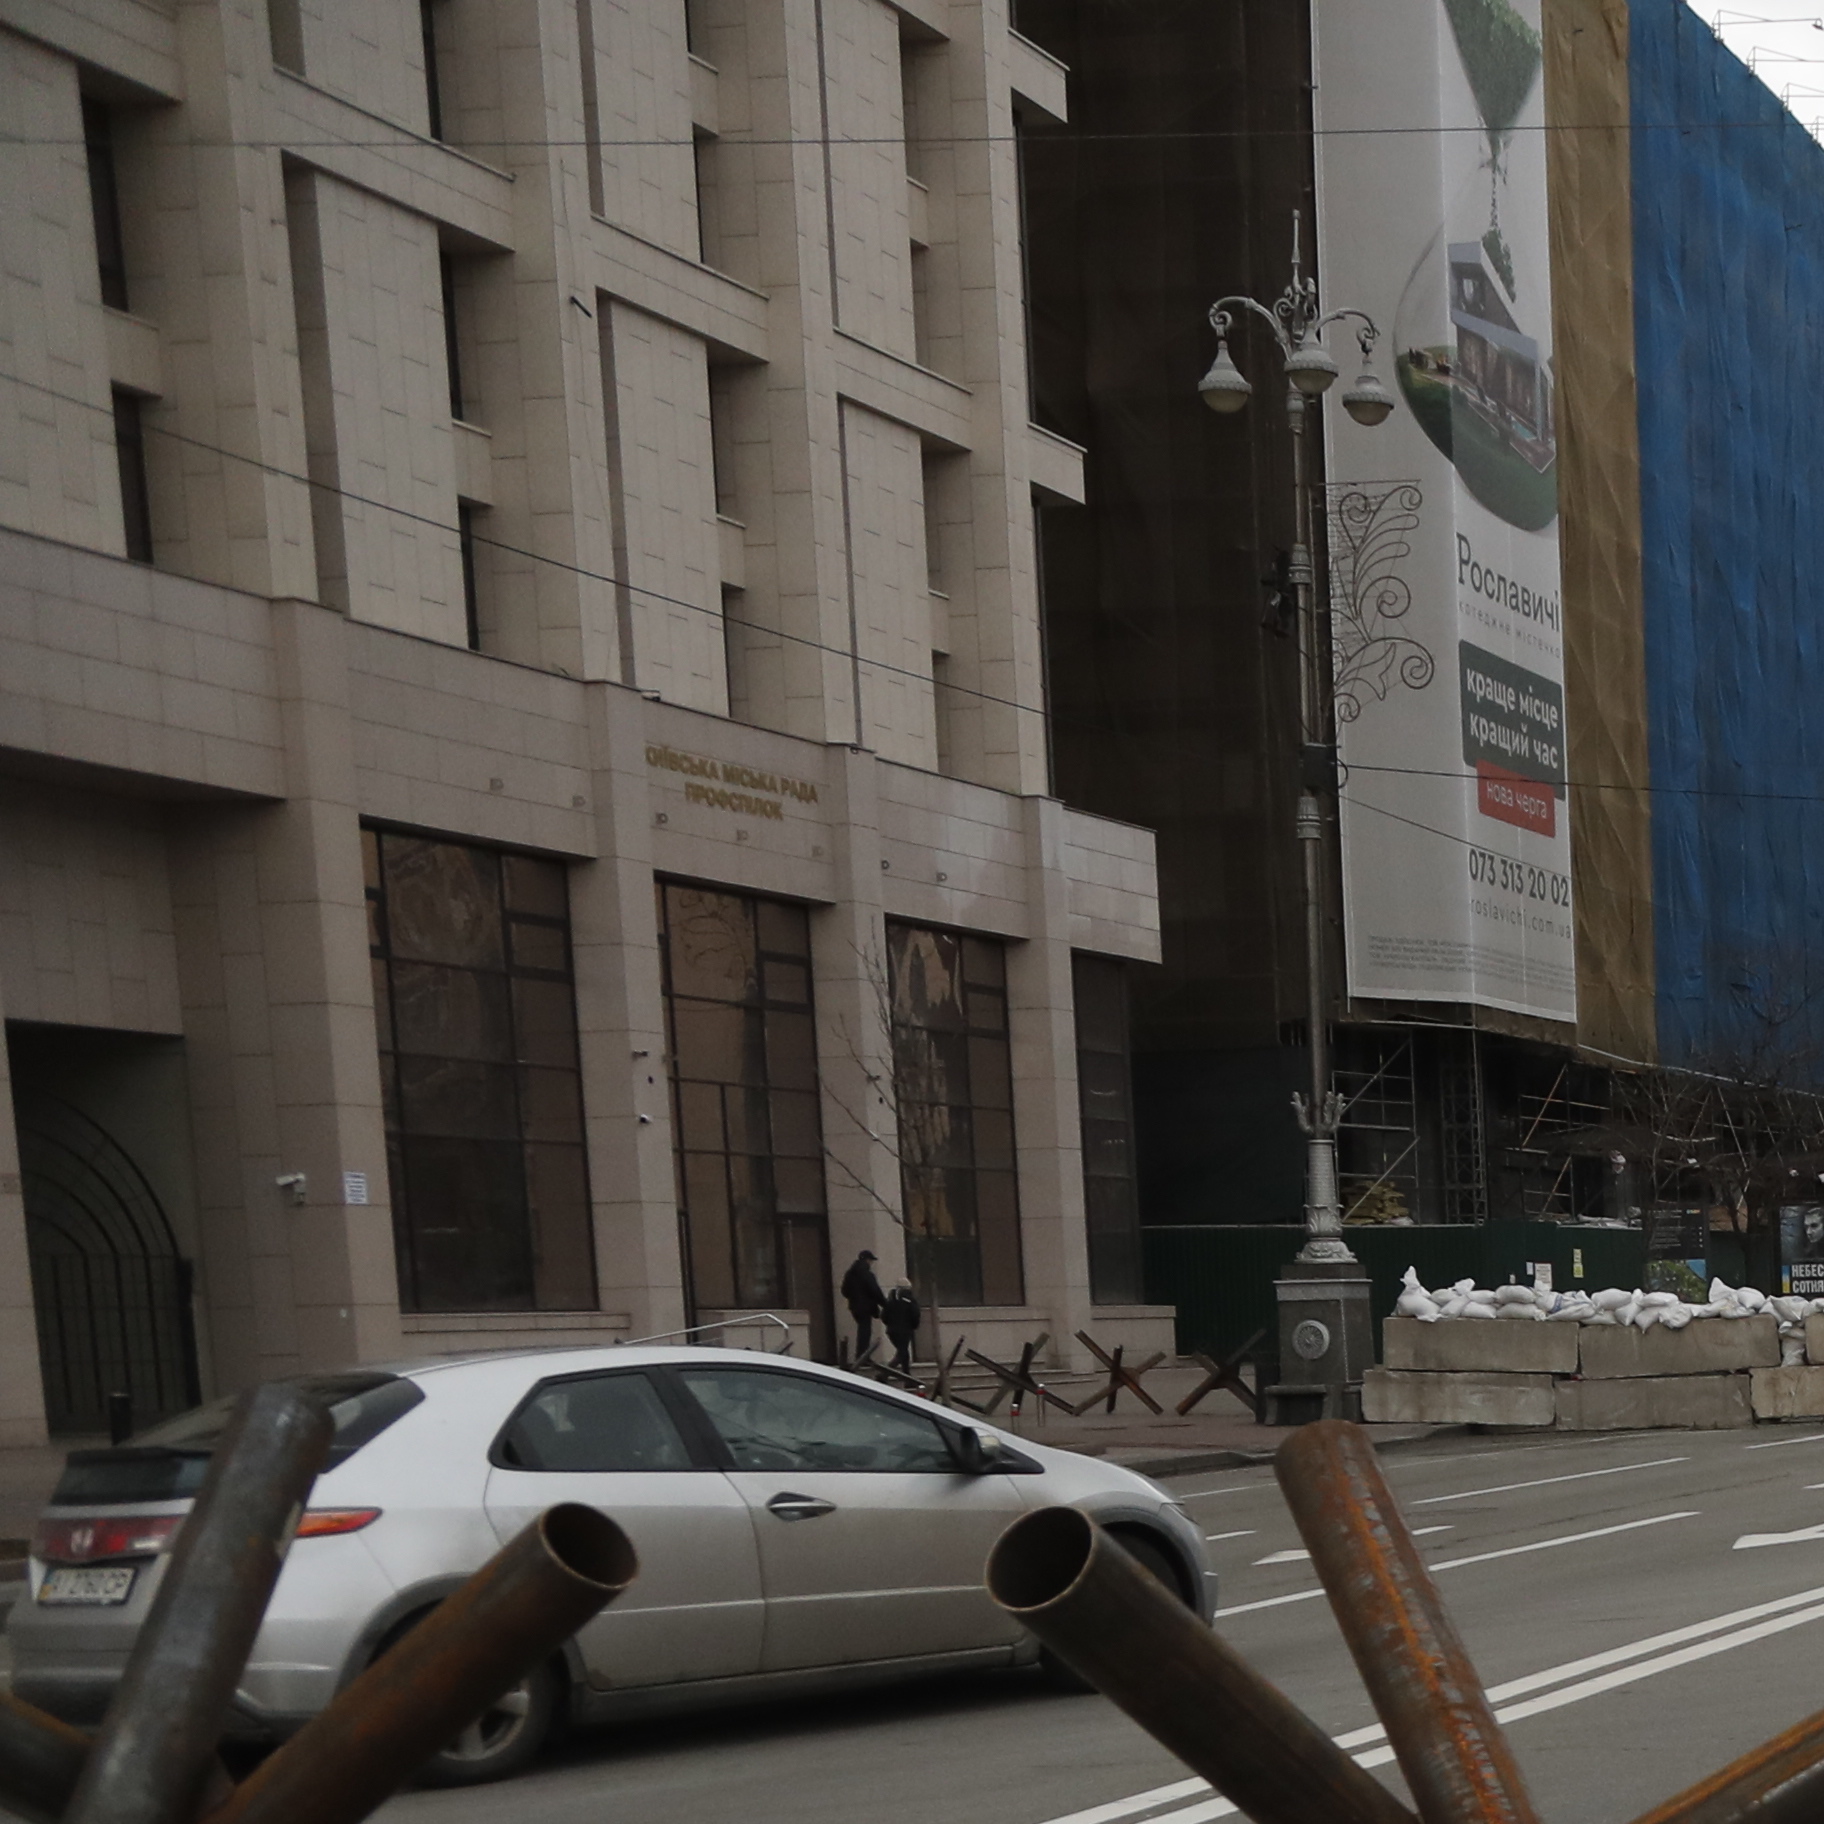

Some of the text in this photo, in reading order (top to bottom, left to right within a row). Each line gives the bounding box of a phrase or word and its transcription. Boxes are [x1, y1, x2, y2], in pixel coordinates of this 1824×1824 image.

[1456, 531, 1560, 632] Рославичі
[1459, 600, 1510, 636] котеджне
[1465, 667, 1559, 732] краще місце
[1469, 712, 1559, 770] кращий час
[684, 781, 785, 822] ПРОФСПІЛОК
[722, 763, 779, 794] МІСЬКА
[780, 776, 819, 805] РАДА
[1485, 780, 1548, 822] нова черга
[1469, 847, 1570, 908] 073 313 20 02
[1470, 897, 1571, 940] roslavichi.com.ua
[1792, 1280, 1824, 1294] СОТНЯ
